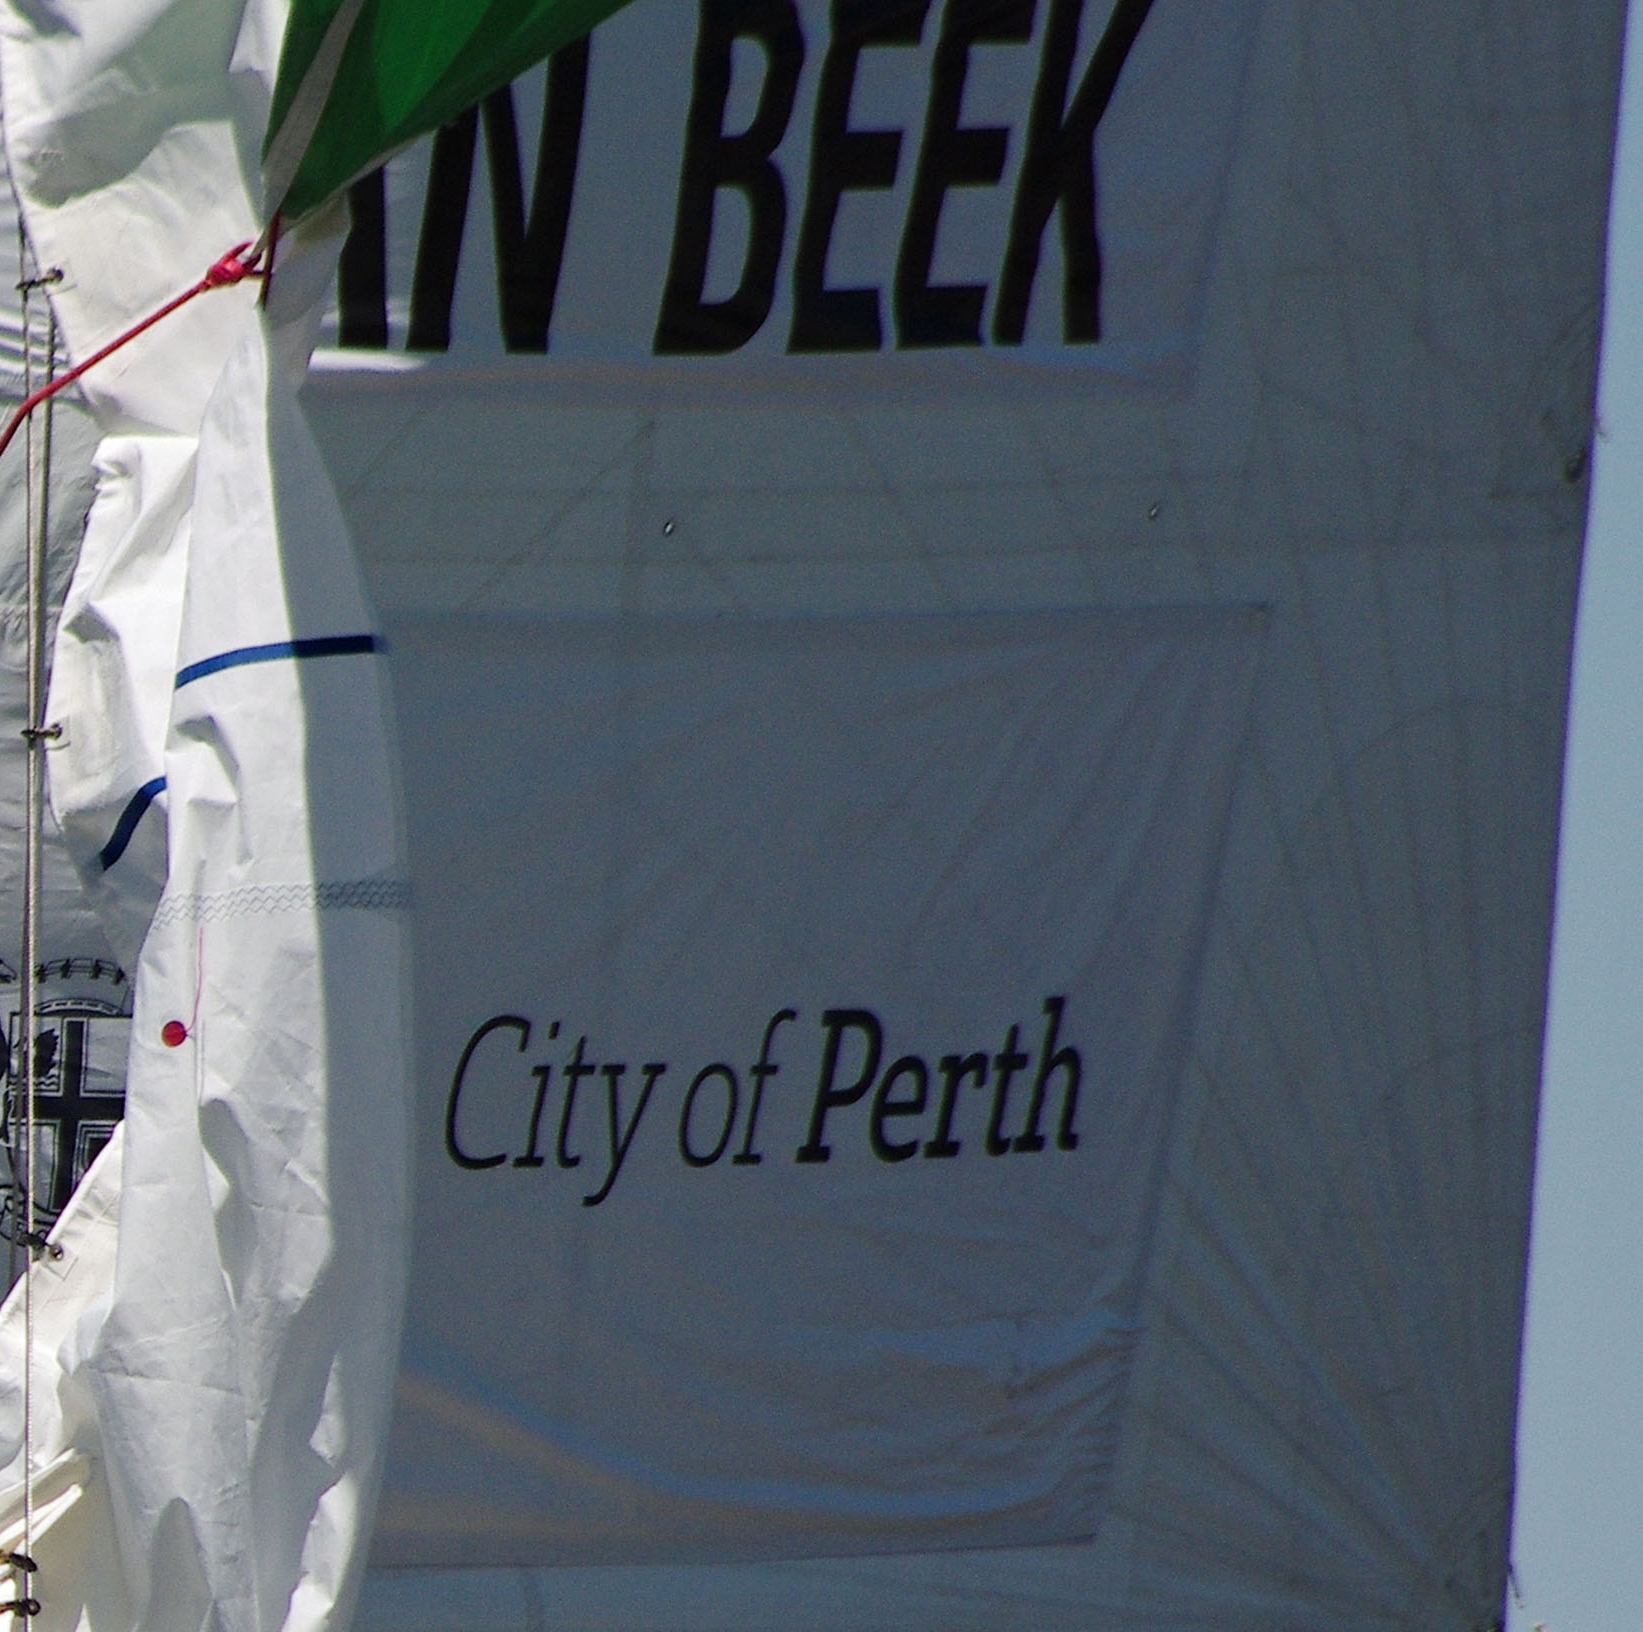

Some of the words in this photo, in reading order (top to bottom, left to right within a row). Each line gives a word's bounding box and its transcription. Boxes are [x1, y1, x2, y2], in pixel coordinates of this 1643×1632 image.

[339, 30, 591, 354] N
[652, 0, 1155, 355] BEEK
[444, 1014, 666, 1207] City
[677, 1009, 797, 1168] of
[795, 996, 1083, 1163] Perth
